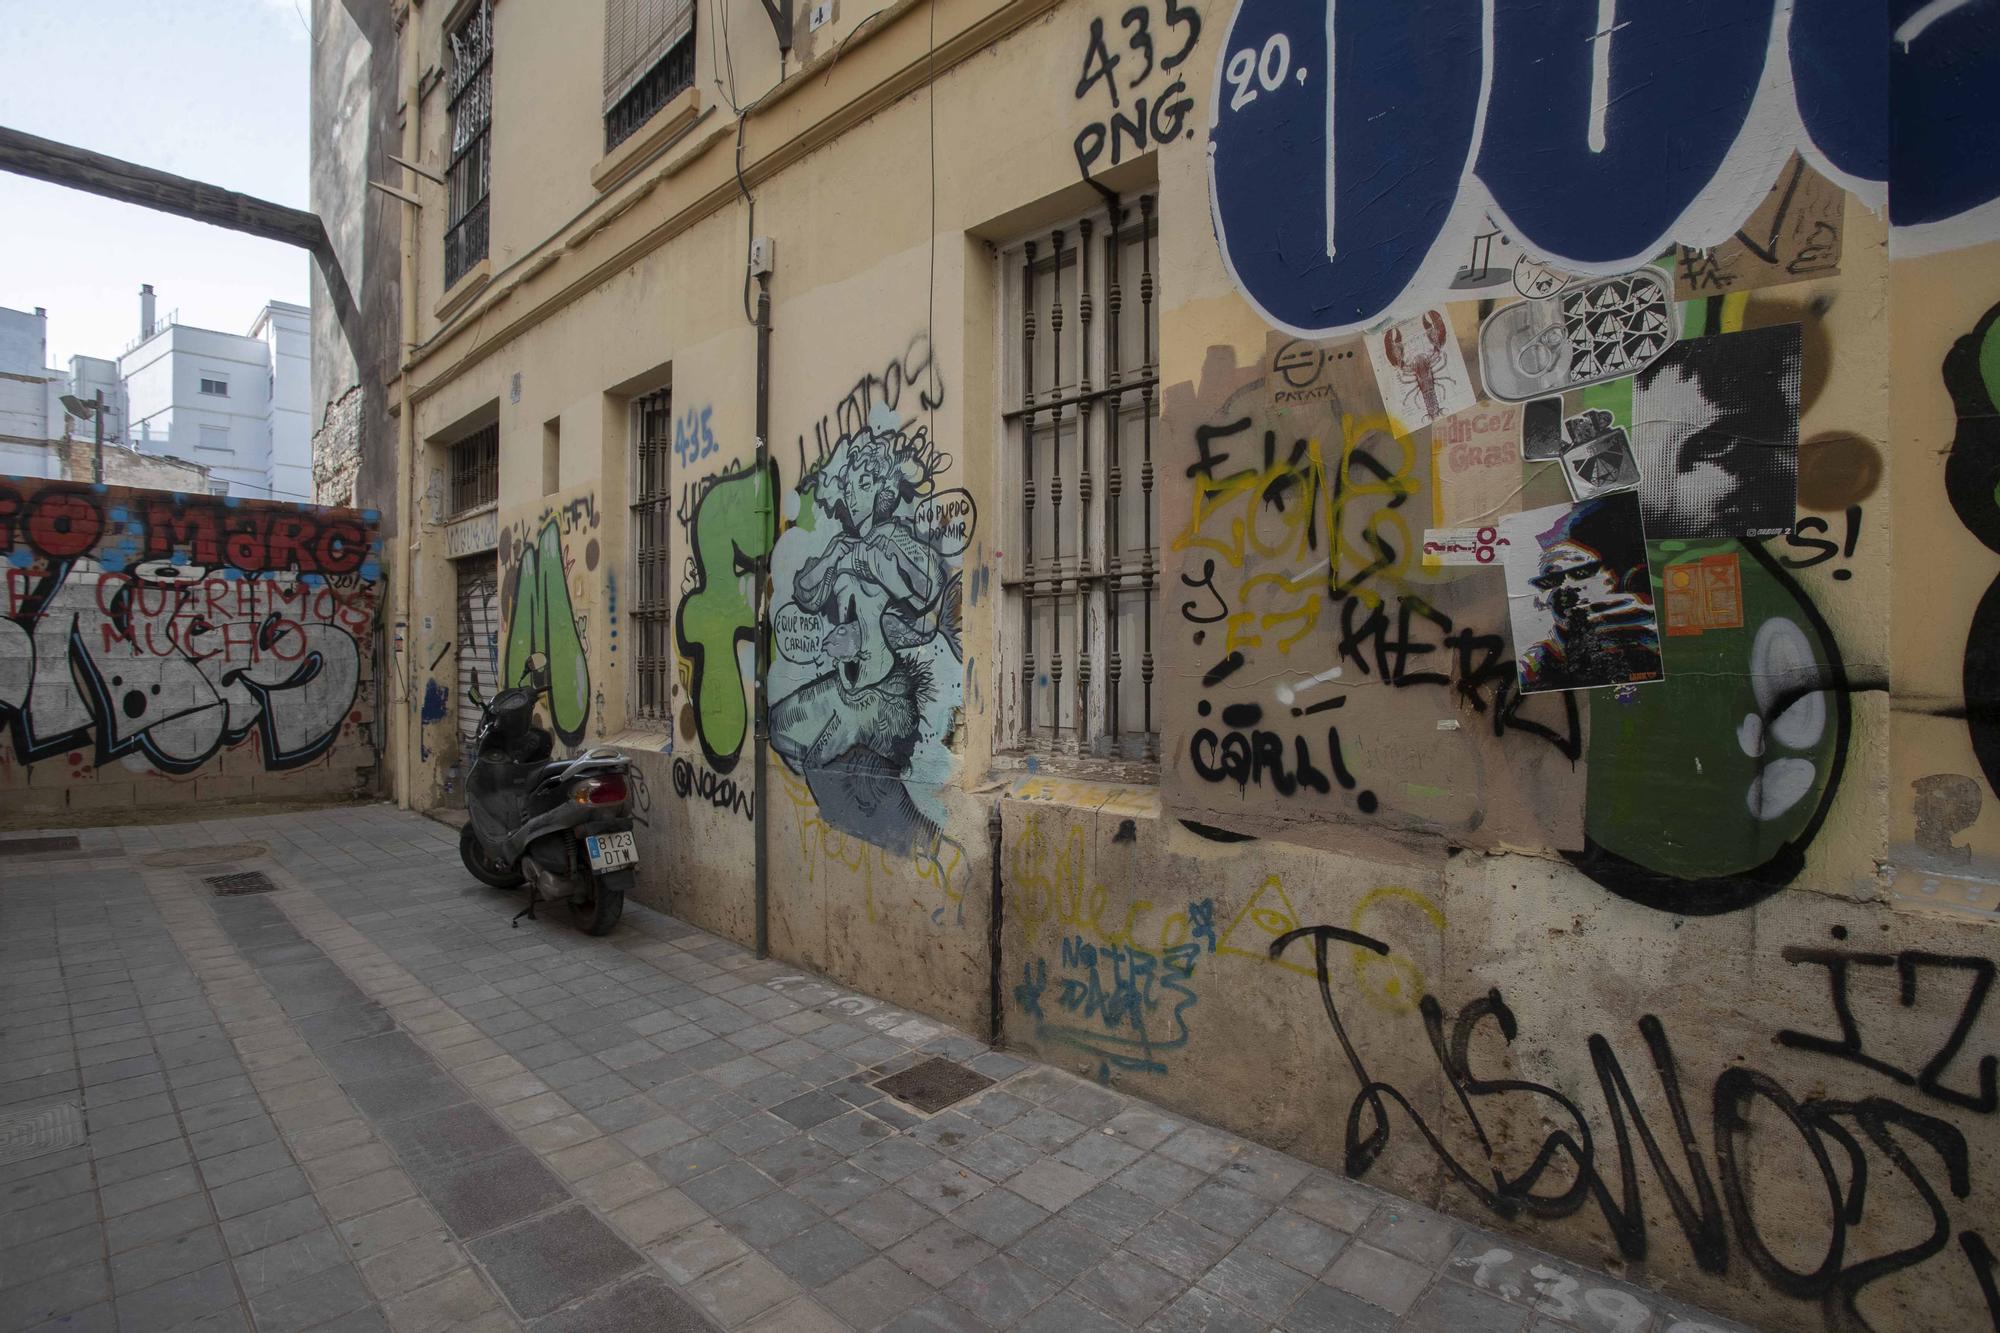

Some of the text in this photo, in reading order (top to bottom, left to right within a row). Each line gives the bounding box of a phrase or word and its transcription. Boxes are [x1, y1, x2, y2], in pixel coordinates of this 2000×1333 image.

[1074, 0, 1202, 108] 435
[1274, 383, 1338, 403] PATATA
[929, 522, 968, 542] DORMIR
[102, 618, 307, 664] MUCHO
[784, 635, 820, 653] CARIÑA?
[599, 833, 633, 850] 8123
[604, 848, 630, 864] DTW
